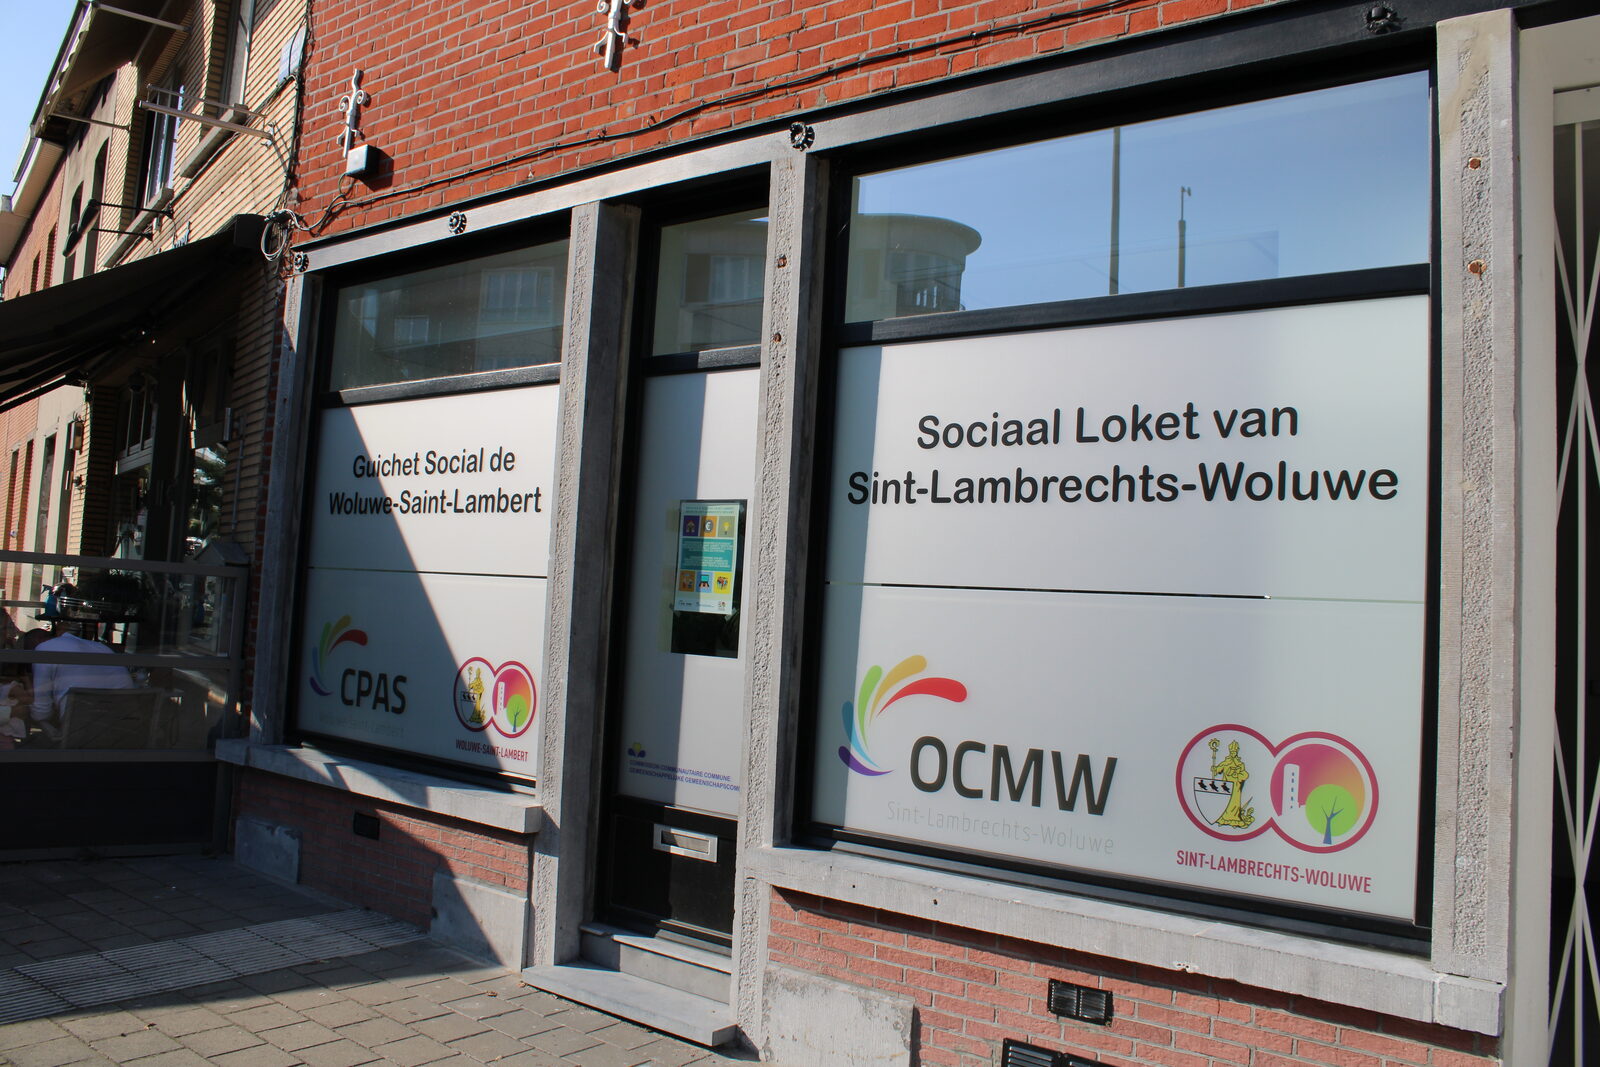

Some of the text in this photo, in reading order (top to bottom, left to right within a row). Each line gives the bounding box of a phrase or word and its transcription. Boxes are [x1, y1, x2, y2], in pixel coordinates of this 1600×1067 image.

[916, 402, 1299, 450] Sociaal Loket van
[353, 446, 515, 479] Guichet Social de
[847, 460, 1399, 505] Sint-Lambrechts-Woluwe
[329, 487, 542, 515] Woluwe-Saint-Lambert
[340, 668, 407, 714] CPAS
[455, 739, 528, 763] WOLUWE-SAINT-LAMBERT
[704, 772, 731, 782] COMMUNE
[910, 735, 1118, 816] OCMW
[887, 801, 1114, 855] Sint-Lambrechts-Woluwe
[1176, 850, 1371, 893] SINT-LAMBRECHTS-WOLUWE
